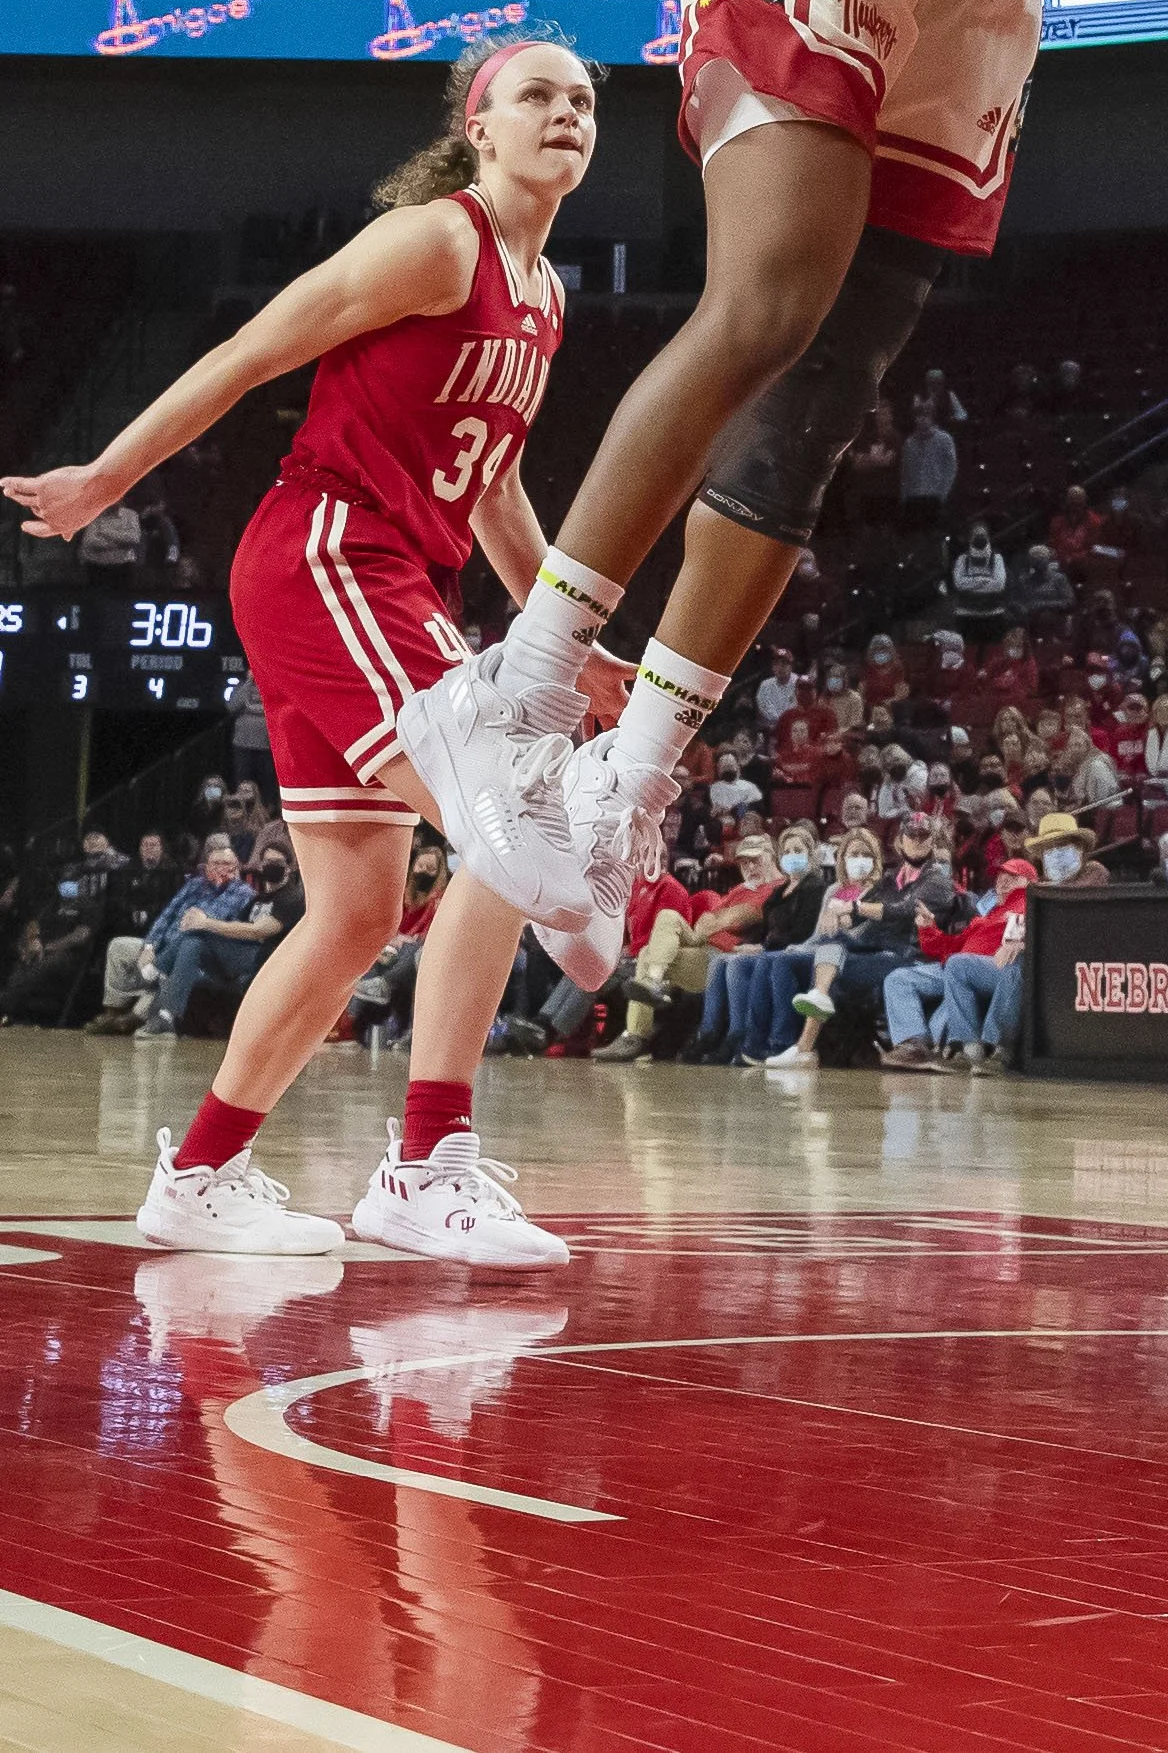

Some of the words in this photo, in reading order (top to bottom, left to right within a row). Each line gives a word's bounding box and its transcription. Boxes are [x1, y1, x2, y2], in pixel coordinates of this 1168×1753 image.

[130, 603, 212, 647] 3:06
[71, 674, 88, 699] 3
[149, 677, 164, 700] 4
